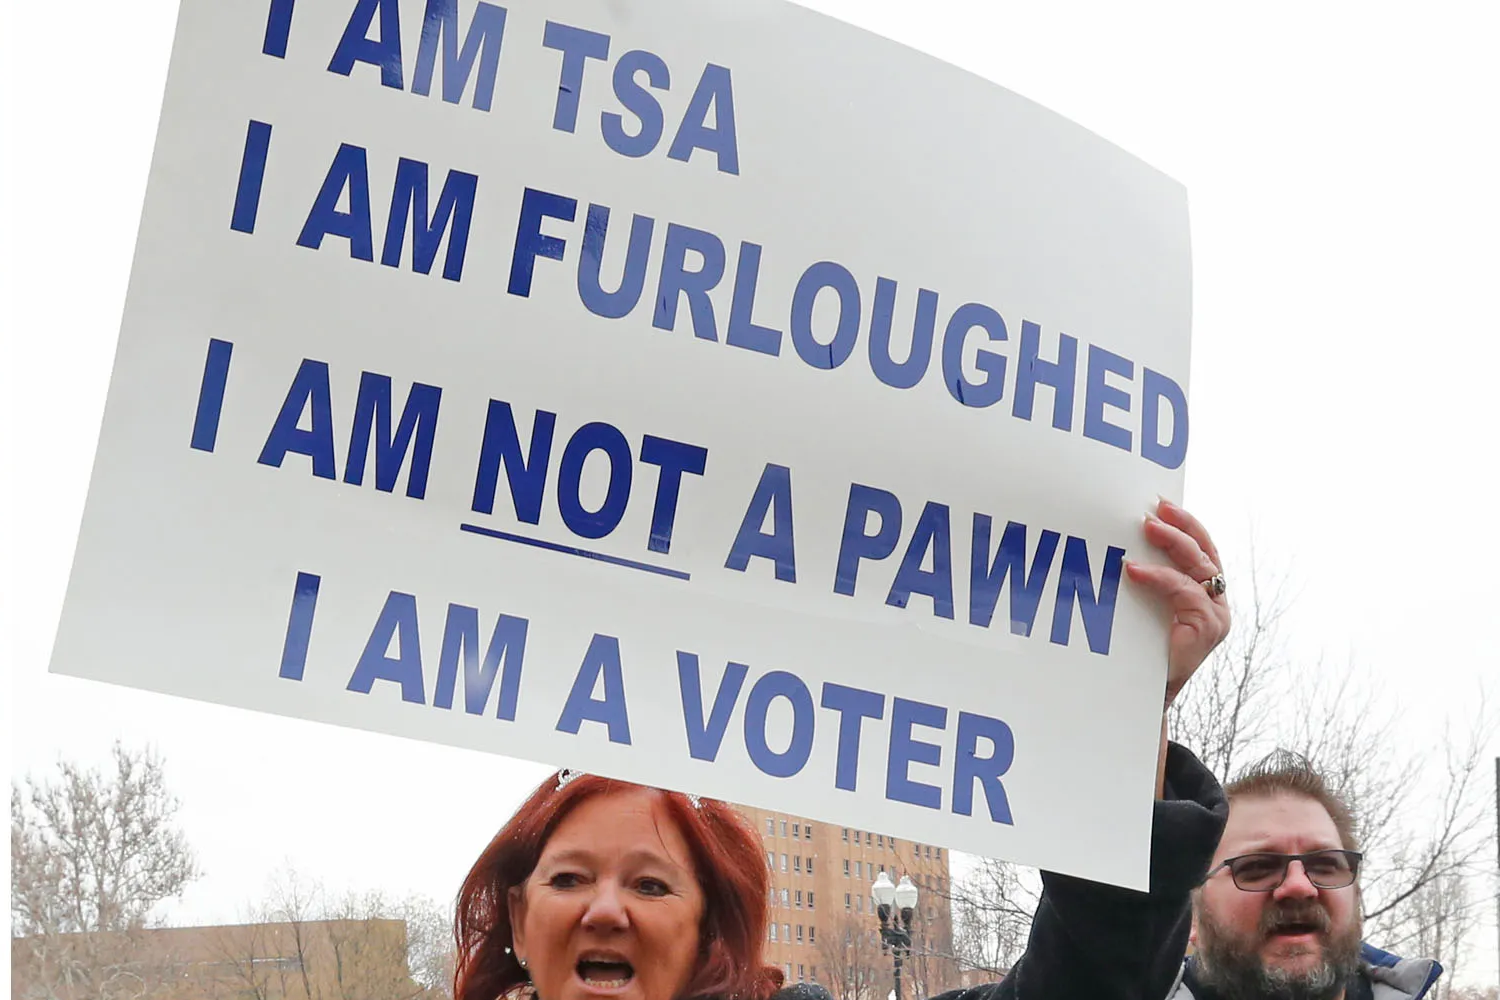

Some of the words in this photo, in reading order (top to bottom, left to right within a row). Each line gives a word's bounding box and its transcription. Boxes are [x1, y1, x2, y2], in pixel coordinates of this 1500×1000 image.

[263, 0, 294, 59] I
[328, 0, 505, 111] AM
[547, 25, 737, 174] TSA
[231, 121, 271, 234] I
[298, 144, 477, 282] AM
[508, 188, 1190, 470] FURLOUGHED
[192, 339, 232, 453] I
[258, 360, 442, 500] AM
[472, 400, 707, 553] NOT
[728, 466, 796, 582] A
[835, 485, 1126, 655] PAWN
[283, 573, 320, 678] I
[352, 593, 527, 719] AM
[559, 636, 630, 743] A
[679, 654, 1013, 825] VOTER
